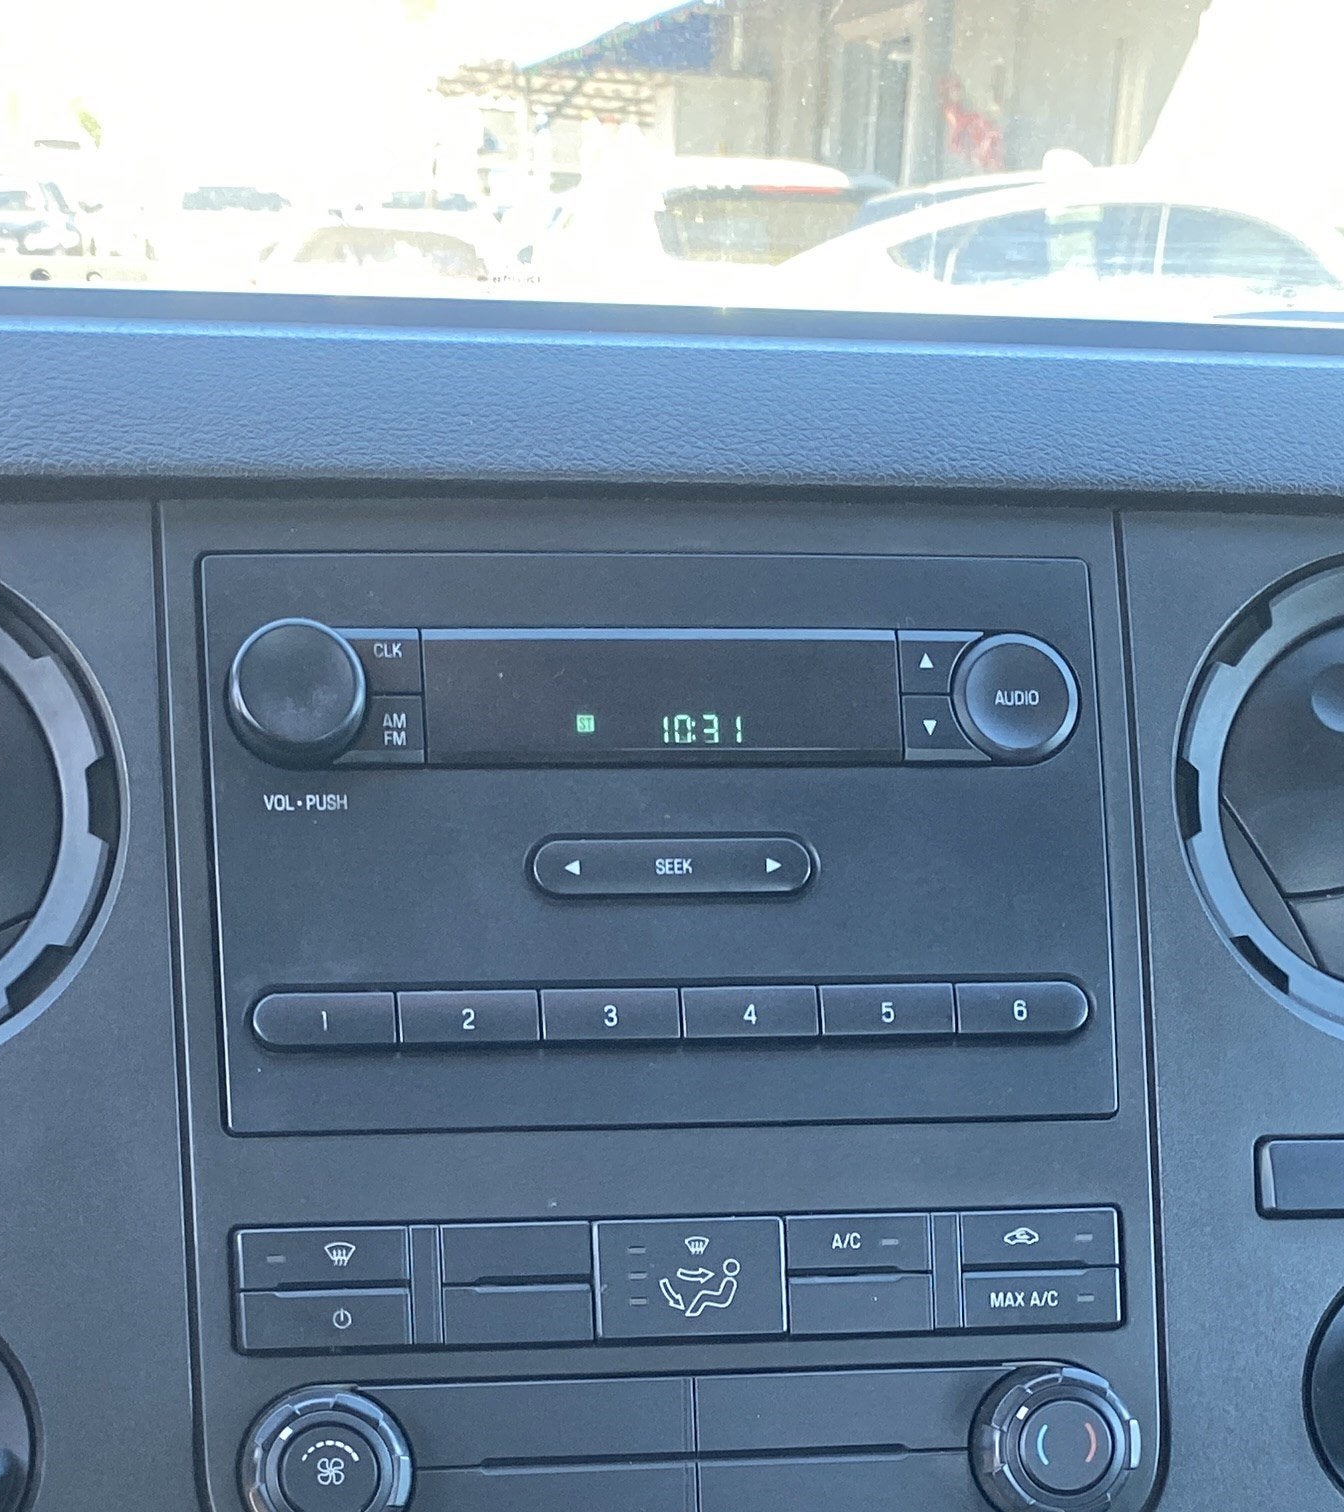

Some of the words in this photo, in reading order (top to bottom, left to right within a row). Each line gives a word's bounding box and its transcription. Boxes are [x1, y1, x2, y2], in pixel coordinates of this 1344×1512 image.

[373, 643, 403, 658] CLK
[994, 689, 1040, 706] AUDIO
[382, 712, 407, 729] AM
[662, 714, 743, 744] 10:31
[384, 731, 407, 746] FM
[305, 794, 349, 811] PUSH
[655, 858, 693, 875] SEEK
[461, 1008, 476, 1030] 2
[603, 1005, 618, 1028] 3
[743, 1002, 758, 1026] 4
[881, 1001, 896, 1023] 5
[1012, 999, 1027, 1021] 6
[320, 1010, 329, 1031] 1
[831, 1232, 861, 1250] A/C
[990, 1291, 1025, 1308] MAX
[1029, 1290, 1059, 1307] A/C
